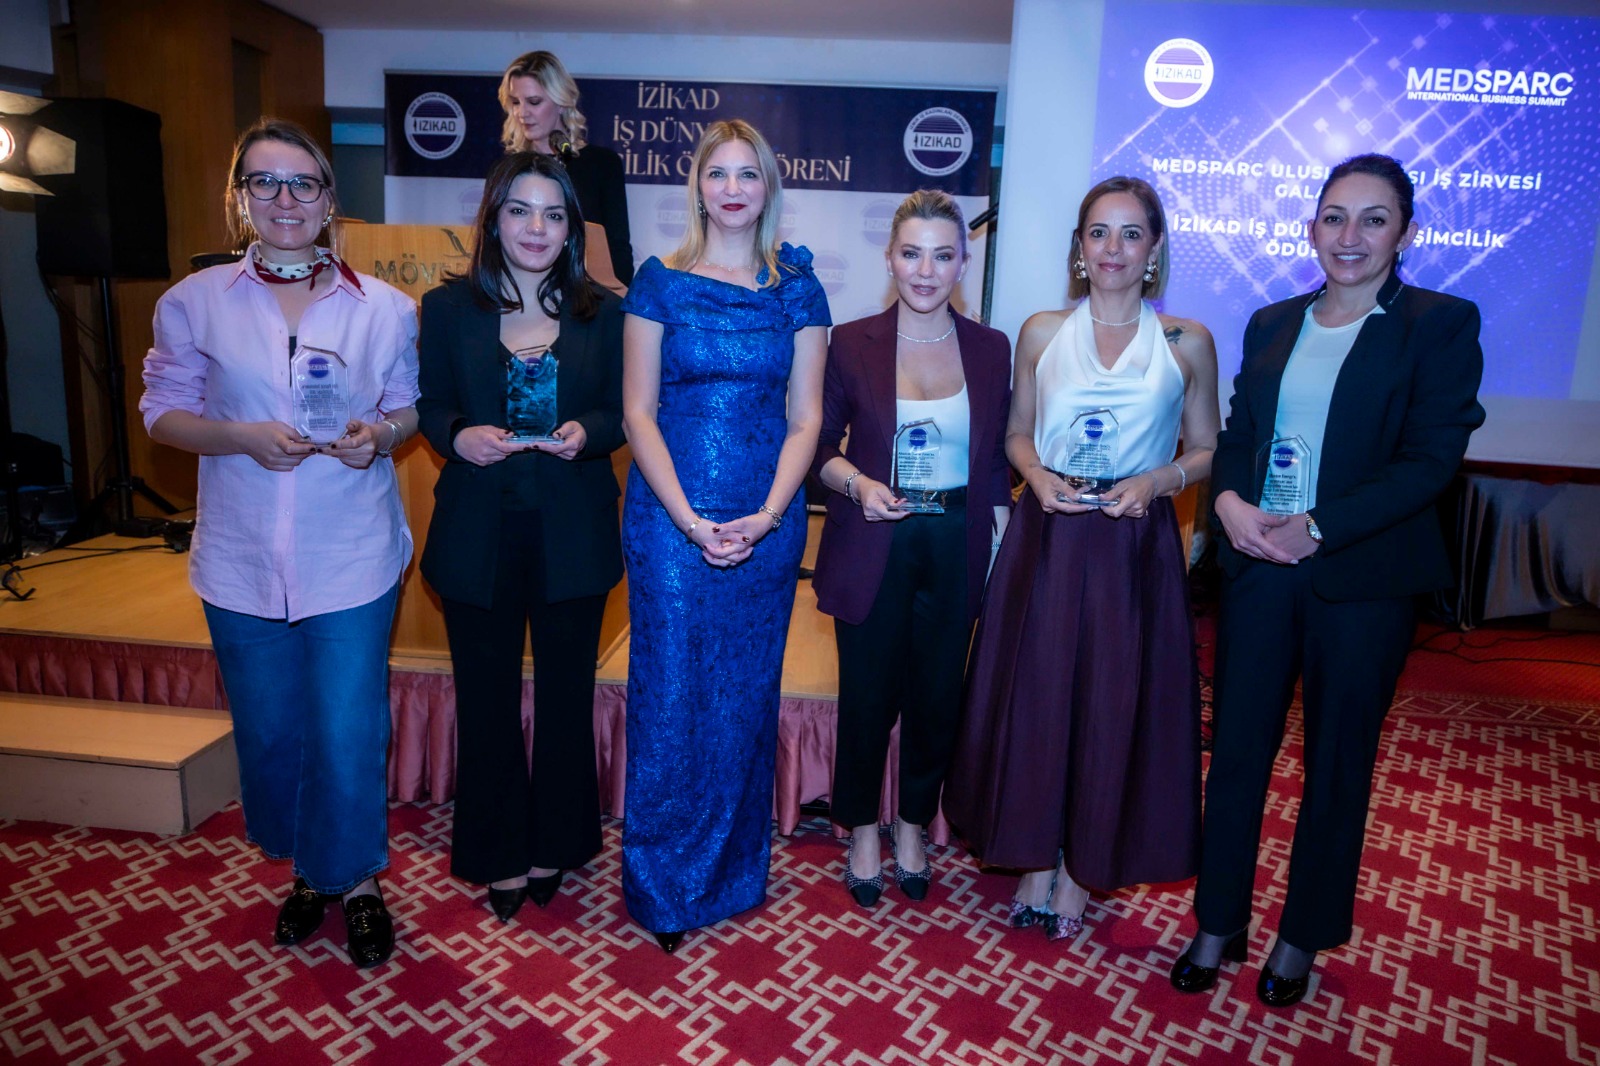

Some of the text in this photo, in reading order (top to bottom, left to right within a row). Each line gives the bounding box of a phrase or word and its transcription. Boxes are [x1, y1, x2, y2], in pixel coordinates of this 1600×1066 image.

[637, 82, 720, 110] İZİKAD
[1406, 67, 1574, 97] MEDSPARC
[1407, 91, 1568, 106] INTERNATIONAL BUSINESS SUMMIT
[613, 115, 635, 148] İŞ
[617, 148, 671, 176] İLİK
[1152, 158, 1263, 177] MEDSPARC
[1433, 168, 1452, 190] İŞ
[1458, 169, 1542, 190] ZİRVESİ
[1173, 213, 1241, 234] İZİKAD
[1248, 217, 1267, 239] İŞ
